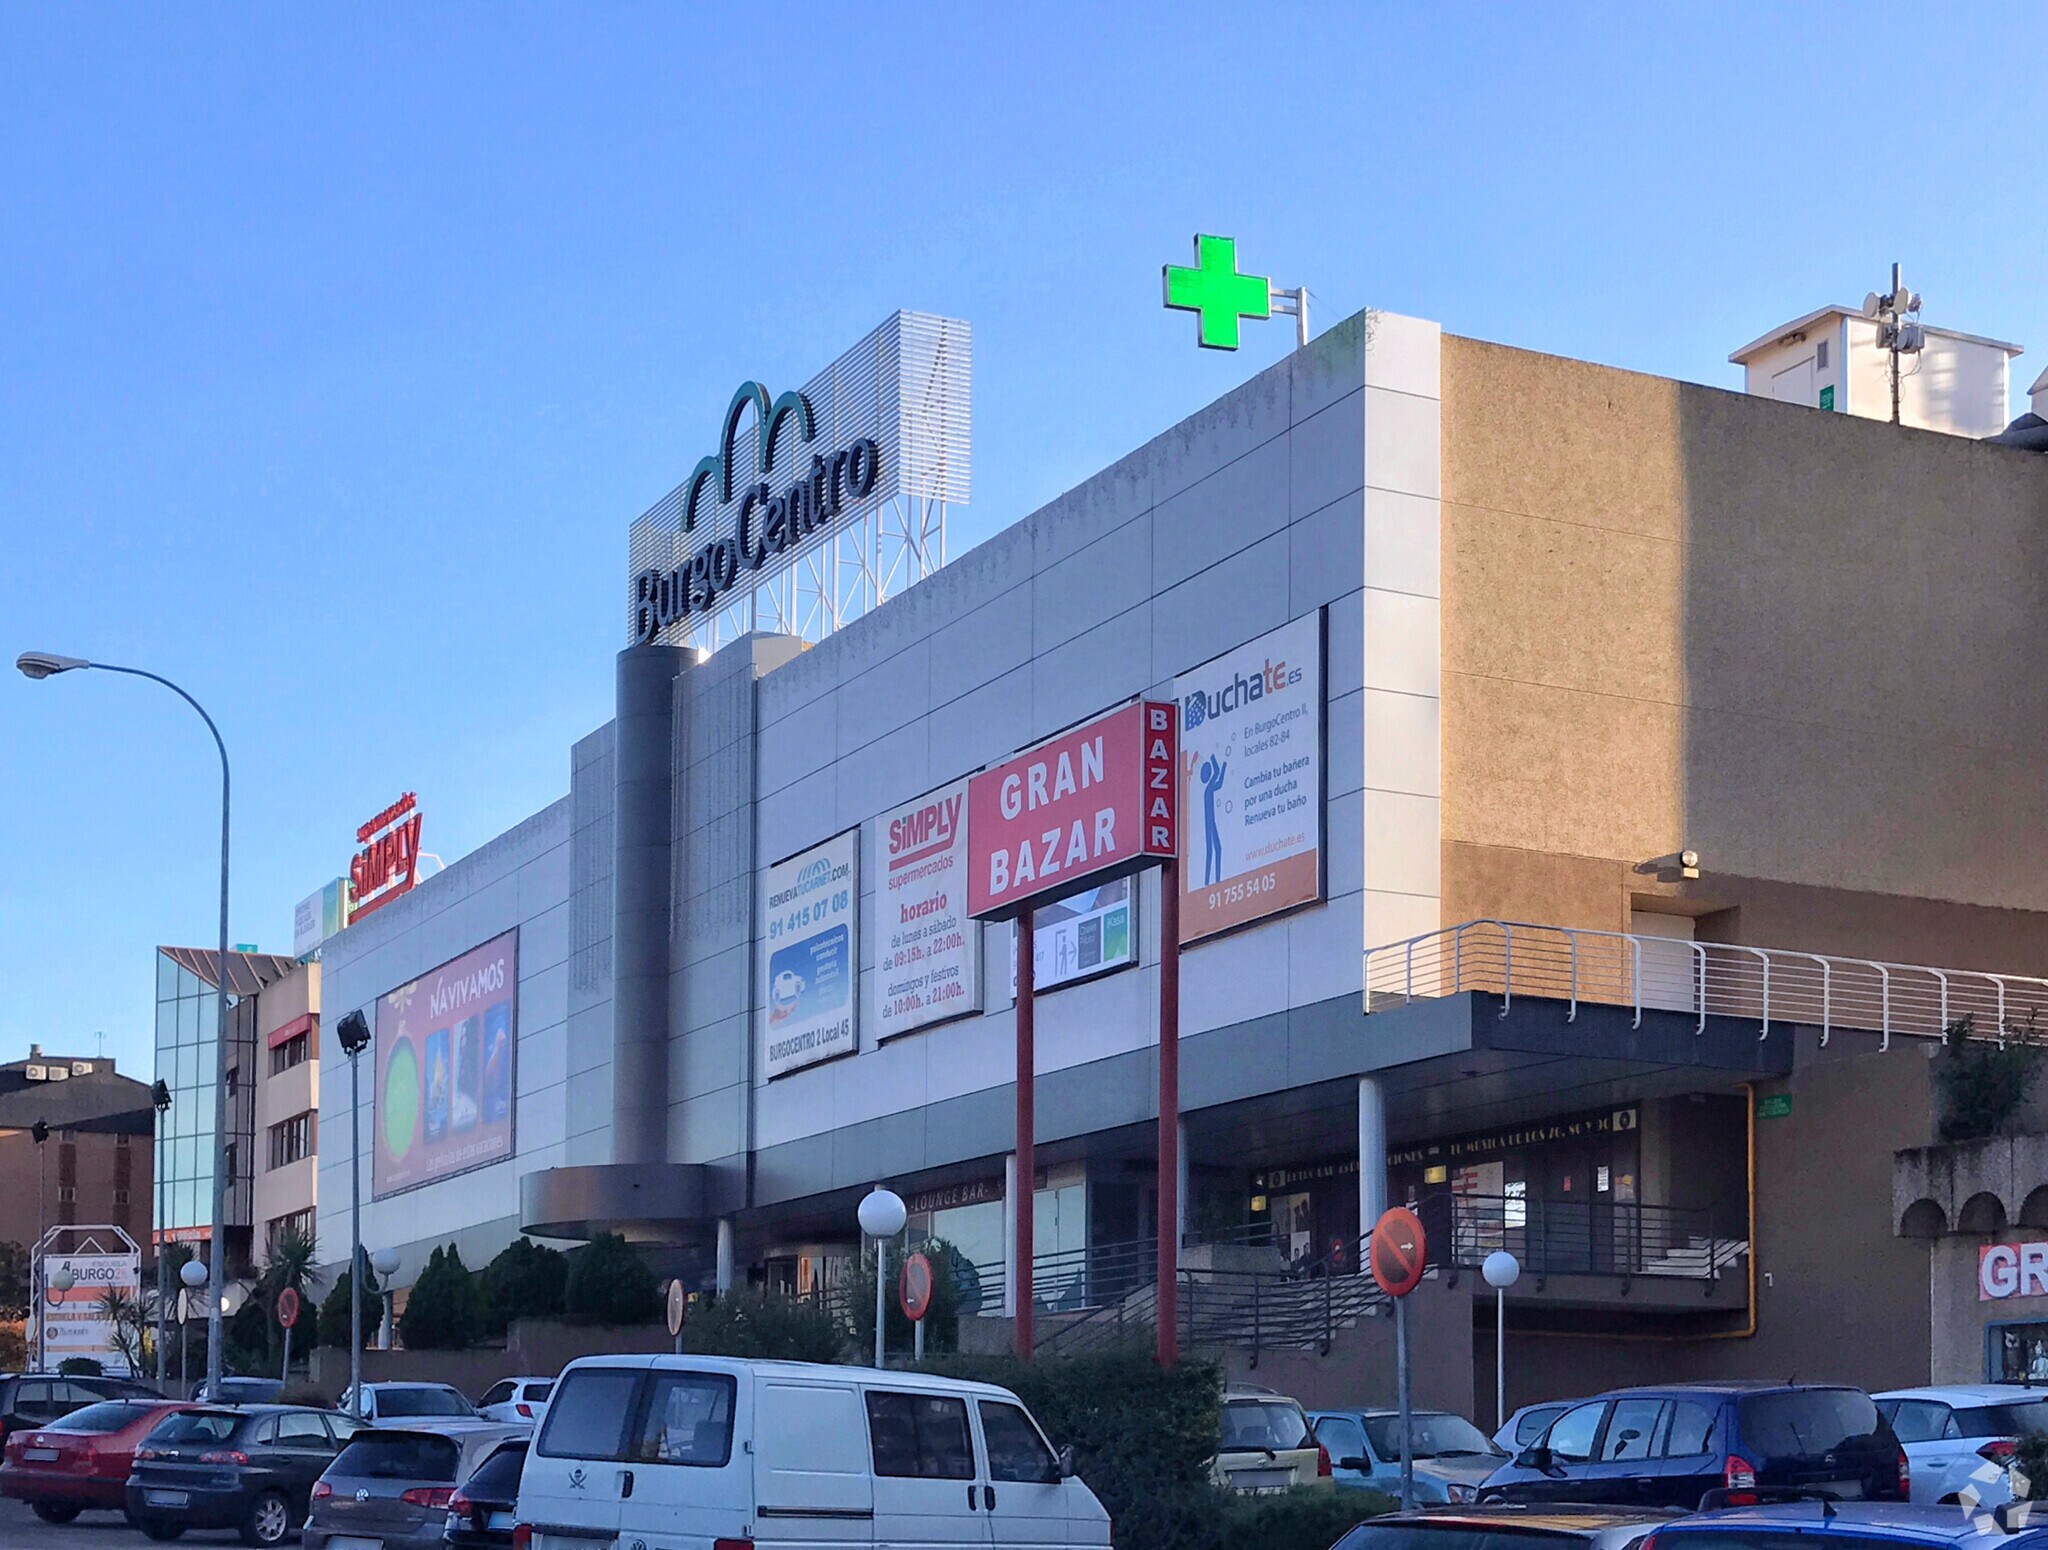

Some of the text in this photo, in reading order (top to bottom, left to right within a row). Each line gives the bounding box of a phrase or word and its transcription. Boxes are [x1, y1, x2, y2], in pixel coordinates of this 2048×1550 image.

[633, 438, 879, 646] BurgoCentro
[1244, 726, 1253, 739] En
[1255, 707, 1301, 735] BurgoCentro
[1244, 729, 1290, 757] locales 82-84
[1000, 736, 1104, 821] GRAN
[1150, 709, 1170, 848] BAZAR
[1244, 756, 1310, 789] Cambia tu bañera
[1244, 779, 1297, 811] por una ducha
[1244, 795, 1307, 826] Renueva tu baño
[989, 807, 1116, 896] BAZAR
[1245, 831, 1305, 861] www.duchate.es
[889, 855, 953, 890] supermercados
[900, 891, 947, 923] horario
[1209, 872, 1276, 910] 91 755 54 05
[770, 889, 848, 939] 91 415 07 08
[891, 915, 957, 949] de lunes a sábado
[883, 932, 965, 971] de 09:15h. a 22:00h.
[888, 965, 959, 997] domingos y festivos
[883, 982, 965, 1019] de 10:00h. a 21:00h.
[770, 1018, 849, 1062] BURGOCENTRO 2 Local 45
[915, 1182, 985, 1212] LOUNGE BAR
